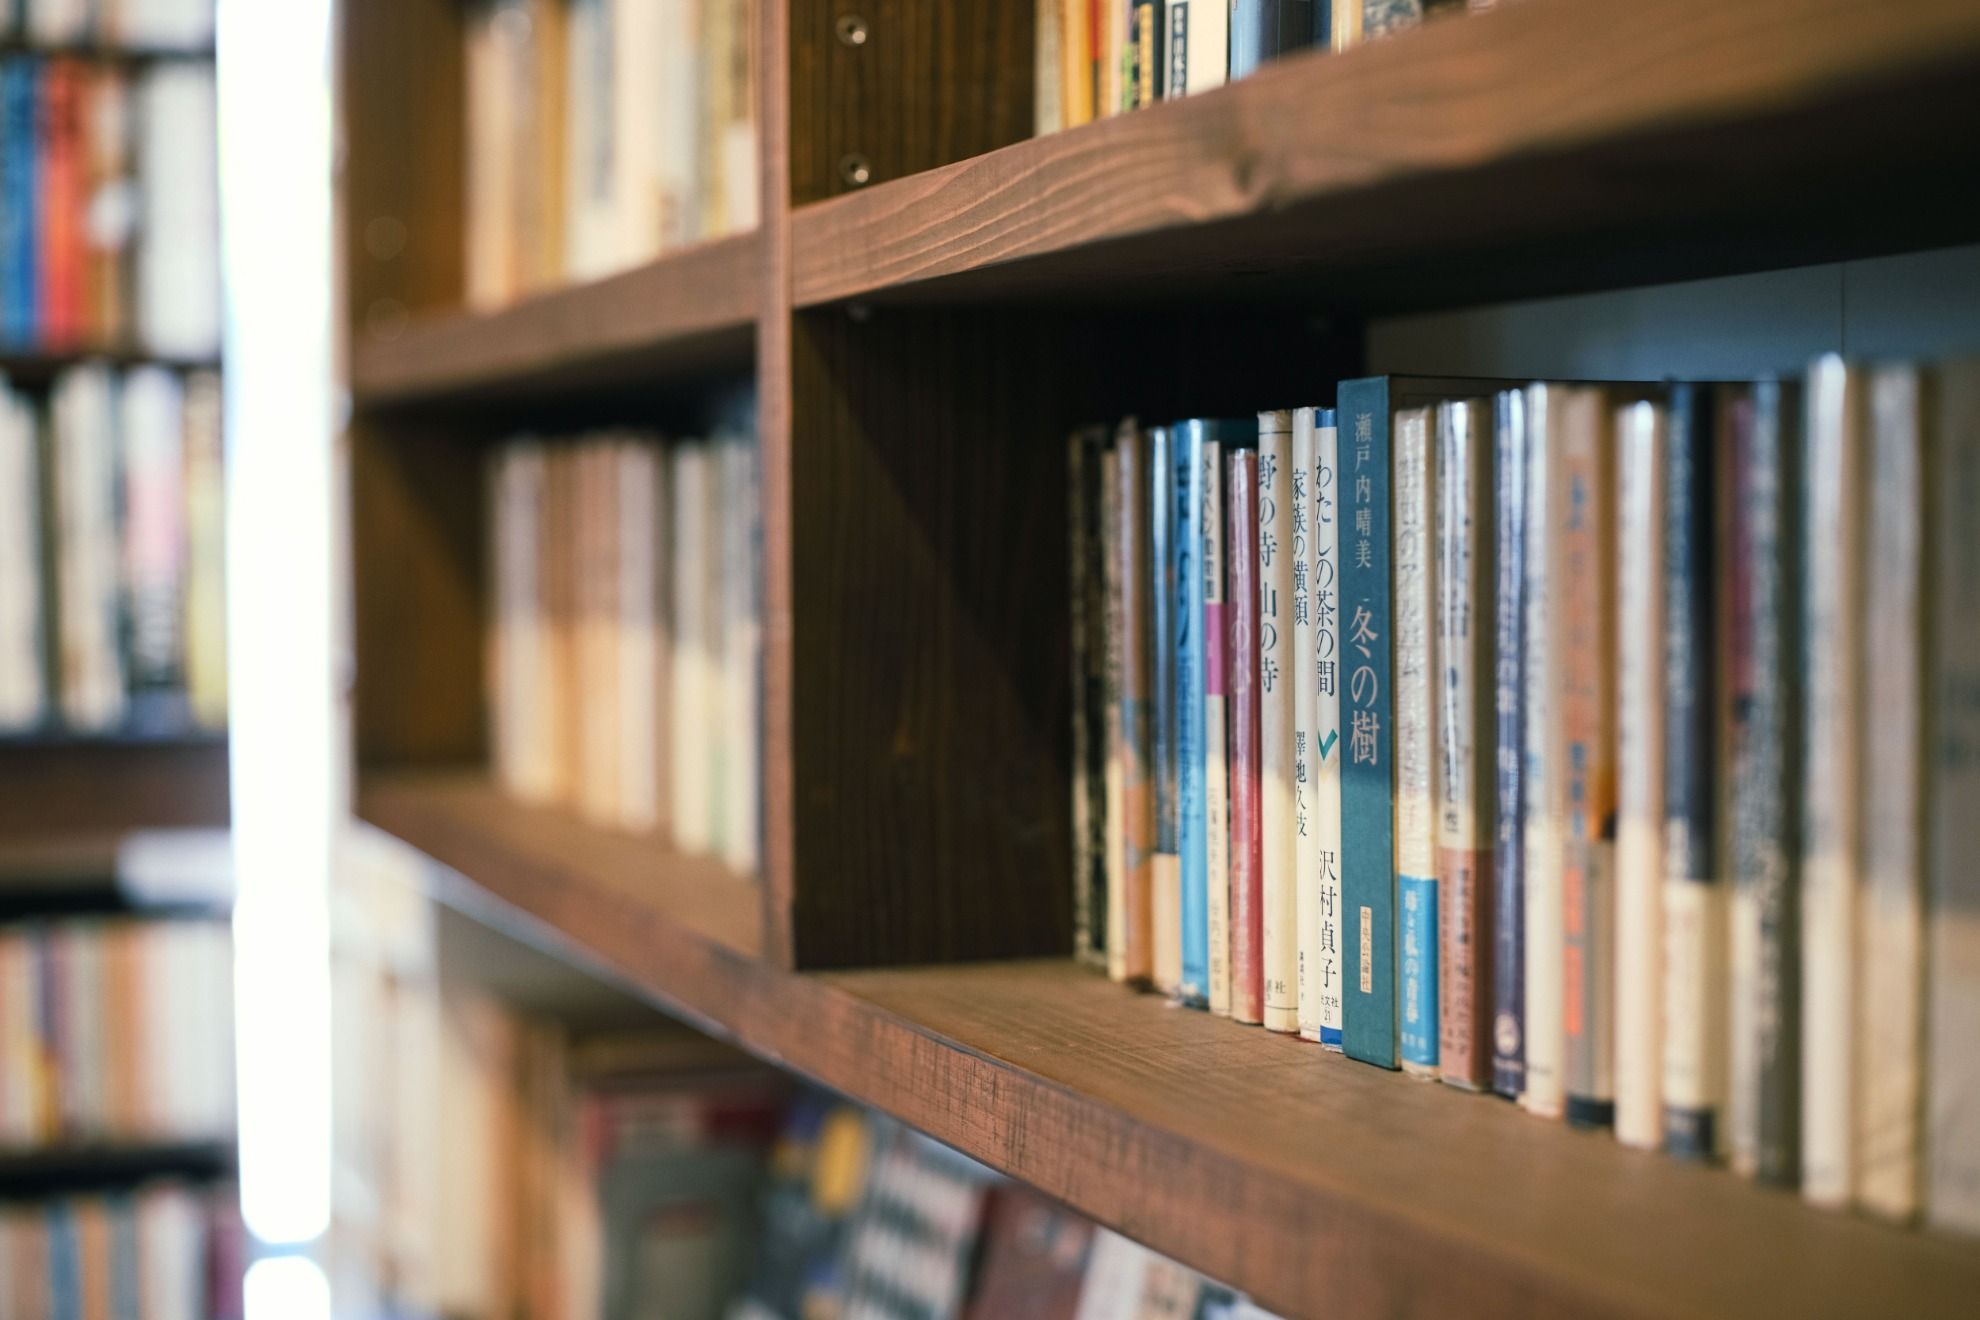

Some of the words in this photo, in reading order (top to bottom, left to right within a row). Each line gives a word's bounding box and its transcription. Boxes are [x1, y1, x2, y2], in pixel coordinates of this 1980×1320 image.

[1259, 453, 1278, 567] 野の寺
[1316, 455, 1336, 697] わたしの茶の間
[1260, 582, 1280, 693] 山の寺
[1349, 604, 1381, 766] 冬の樹
[1319, 849, 1337, 988] 沢村貞子
